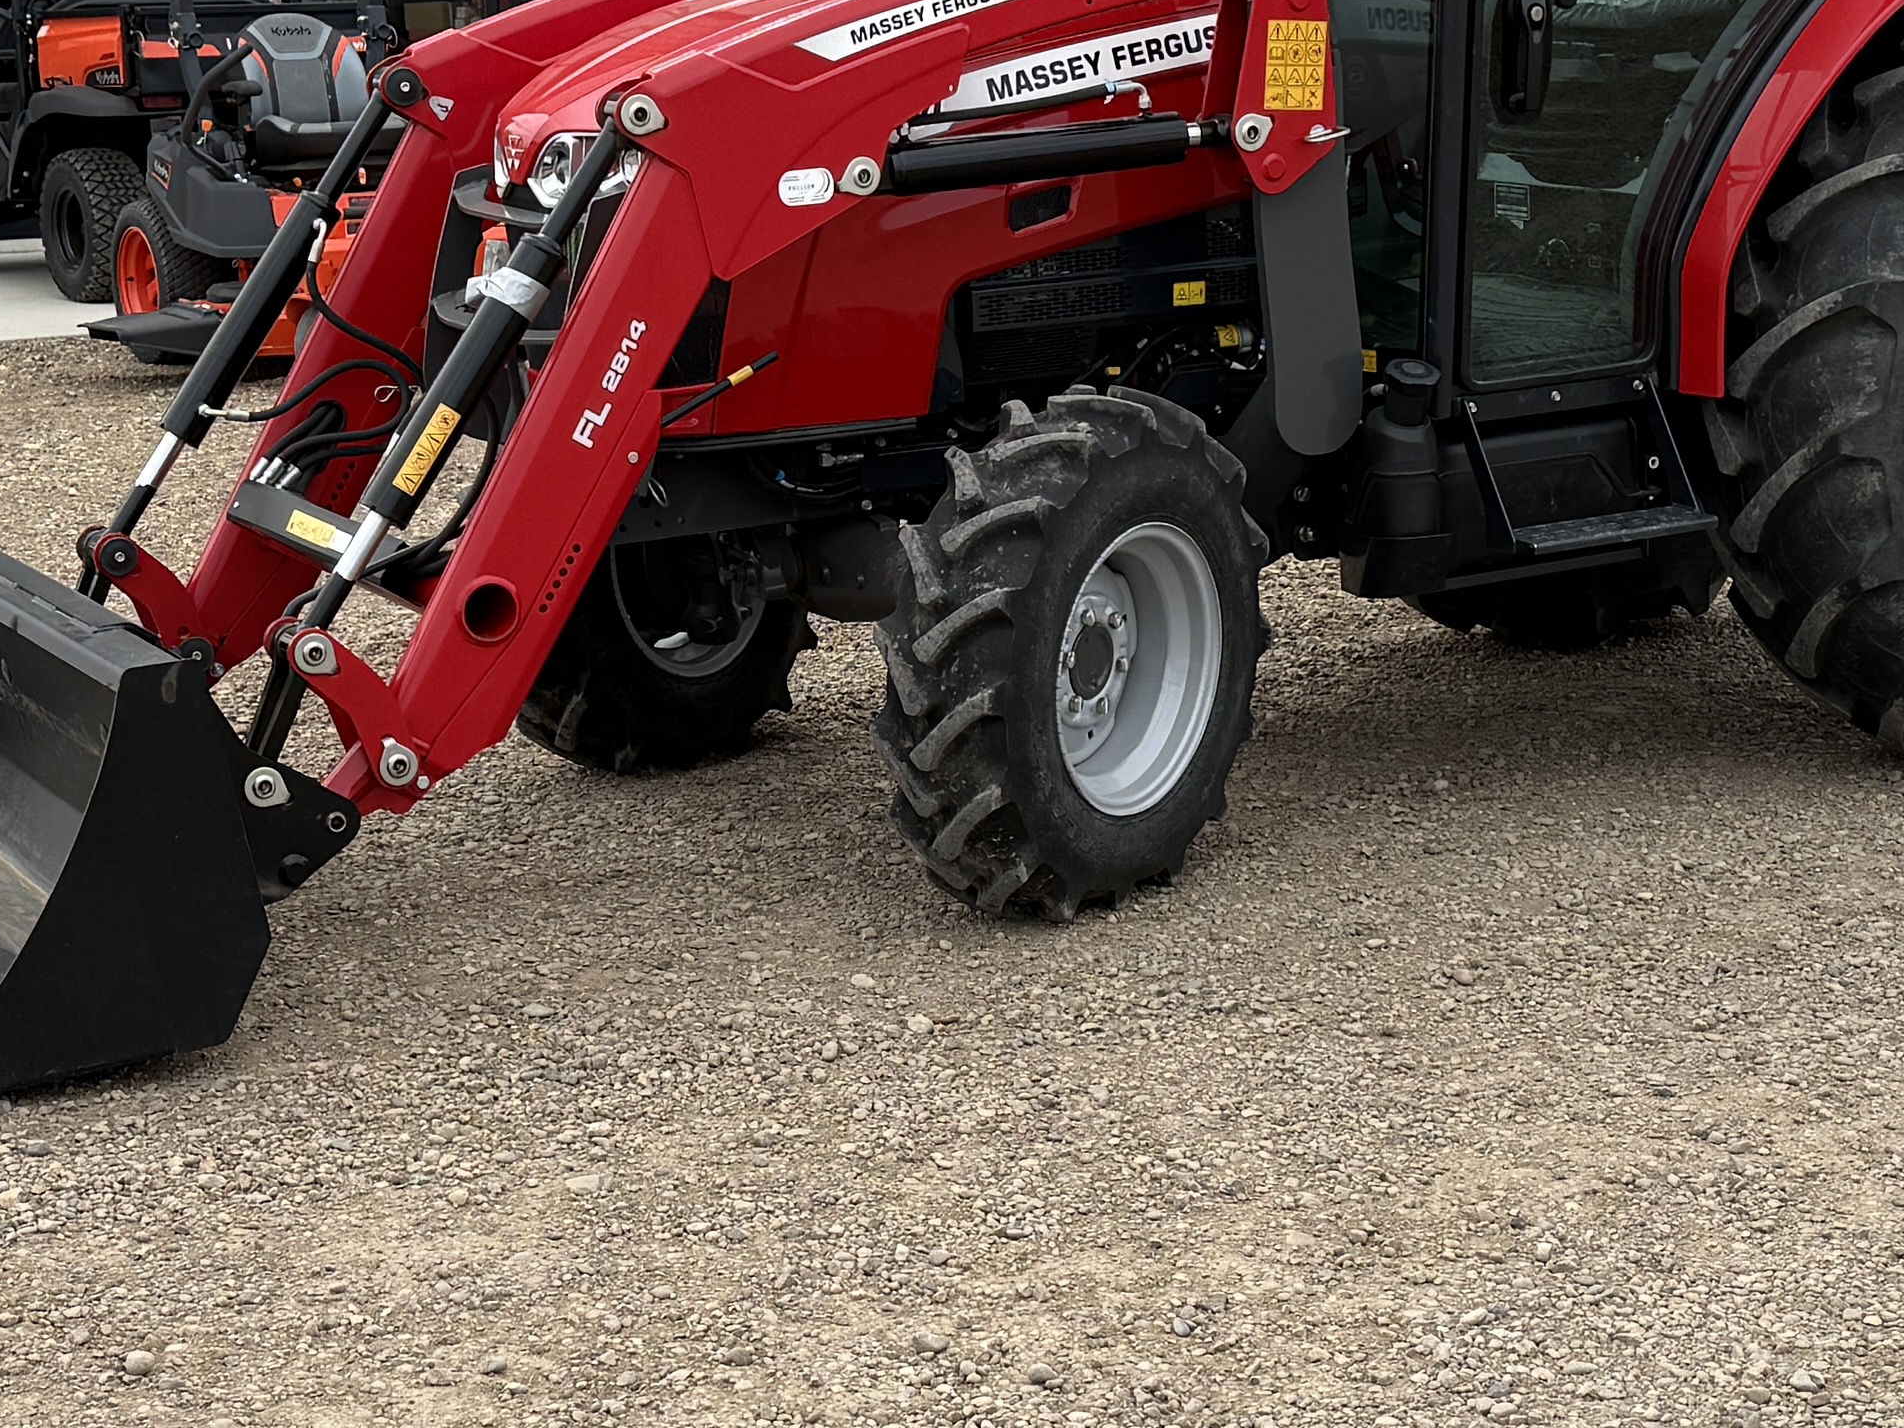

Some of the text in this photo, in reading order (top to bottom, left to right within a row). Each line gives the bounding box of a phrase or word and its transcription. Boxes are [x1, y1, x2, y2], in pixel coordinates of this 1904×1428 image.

[270, 25, 312, 37] Kubota
[850, 6, 926, 46] MASSEY
[986, 51, 1101, 102] MASSEY
[572, 319, 647, 449] FL 2814
